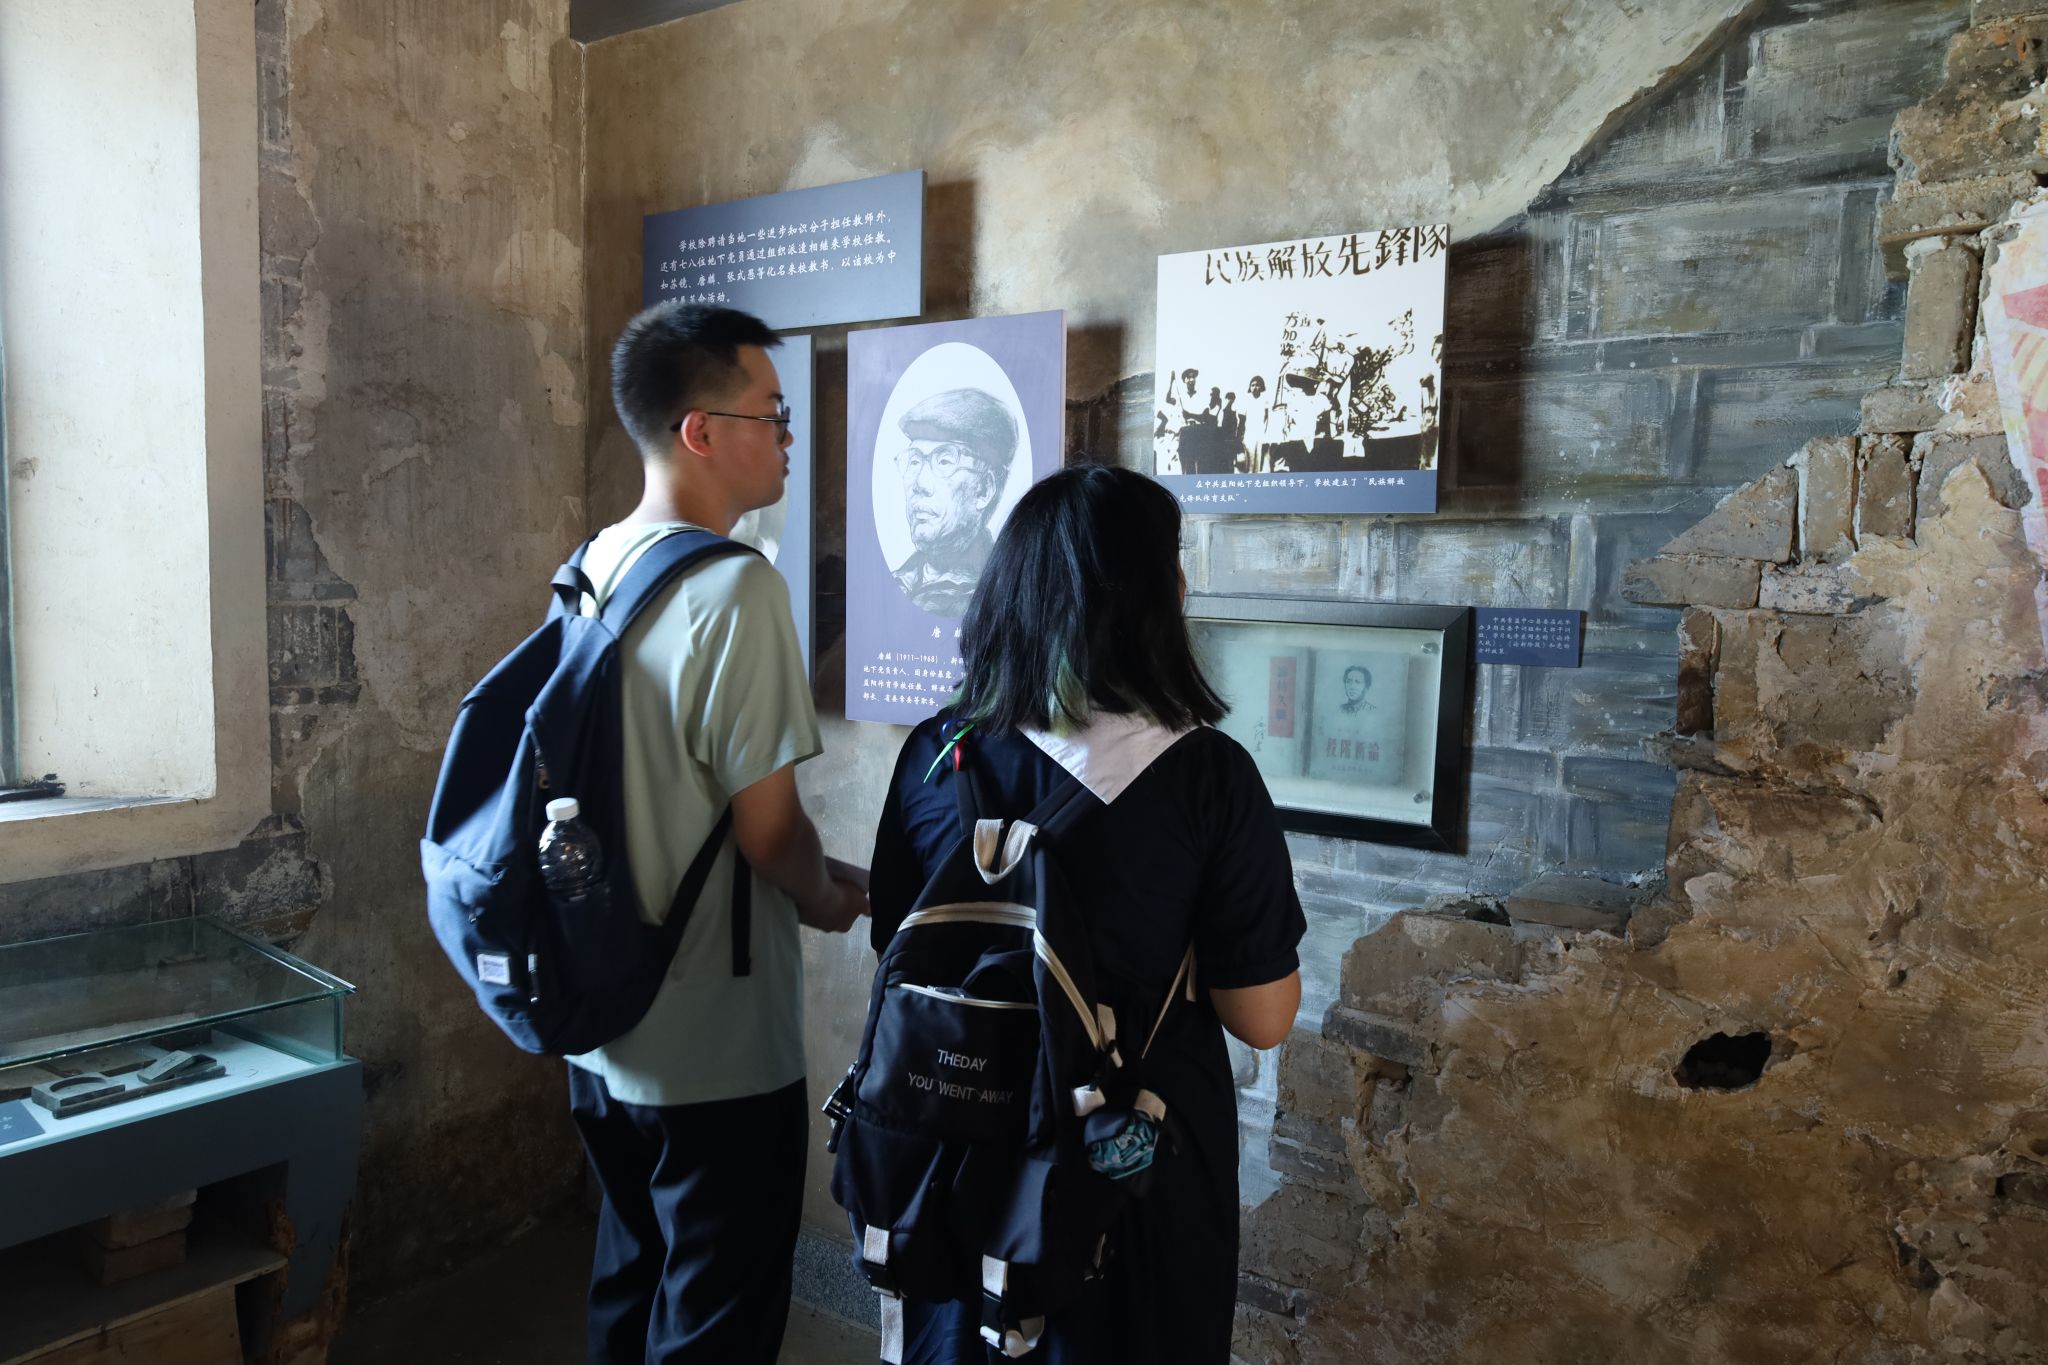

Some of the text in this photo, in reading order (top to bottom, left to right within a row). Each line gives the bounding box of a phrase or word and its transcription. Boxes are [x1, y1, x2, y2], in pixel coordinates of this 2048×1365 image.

[908, 1072, 1014, 1104] YOU WENT AWAY
